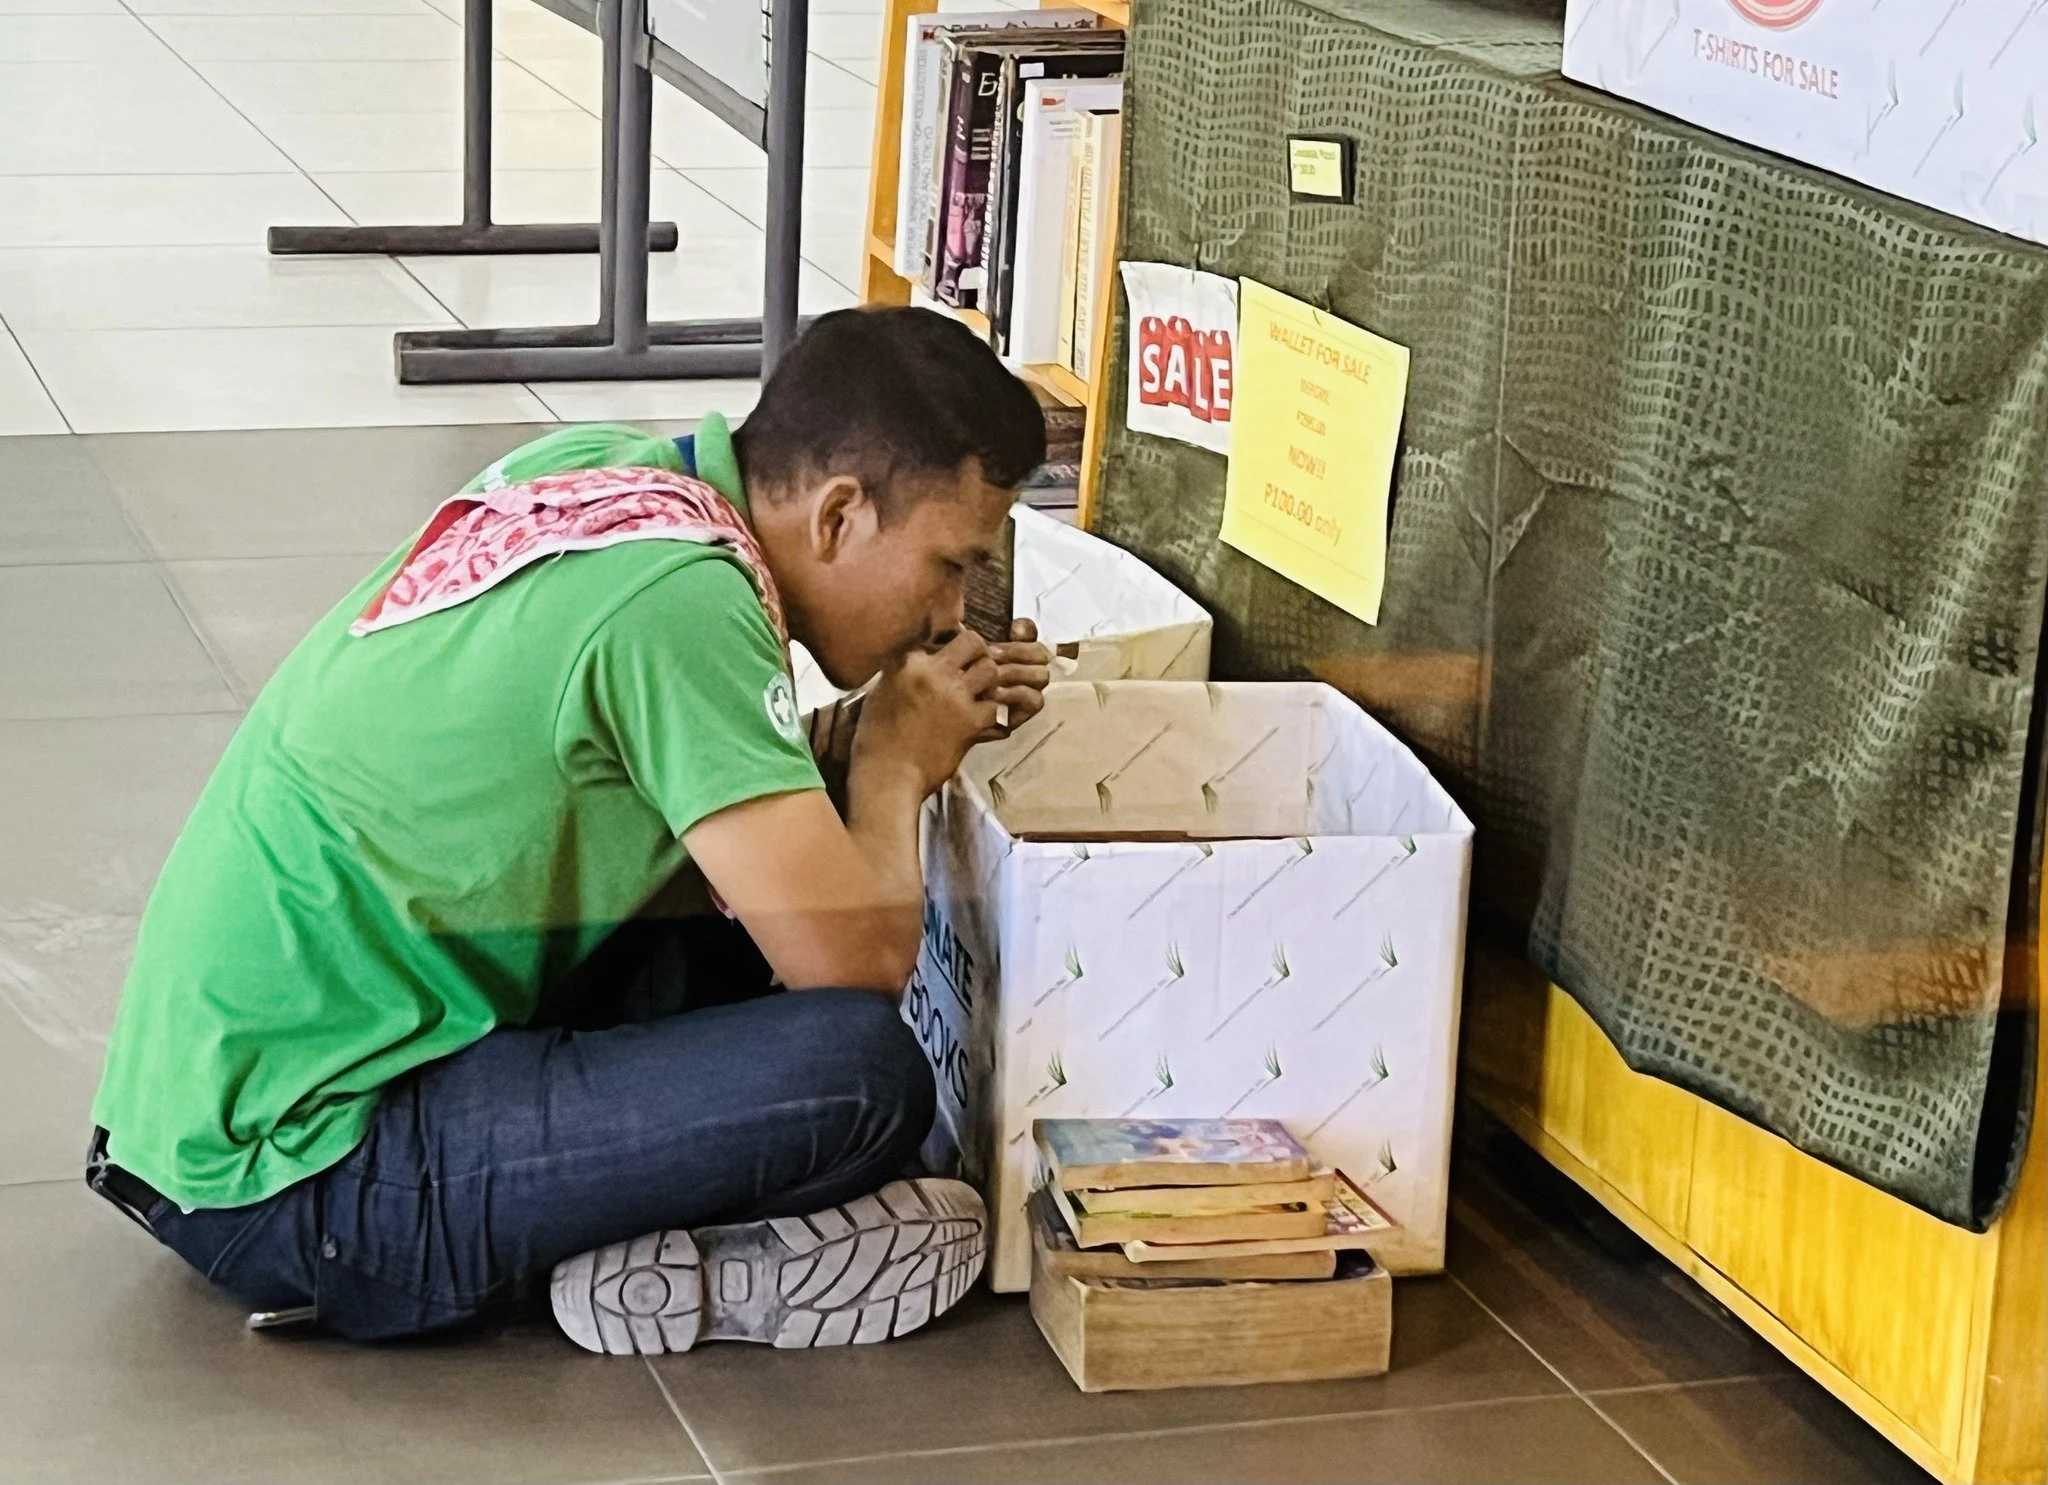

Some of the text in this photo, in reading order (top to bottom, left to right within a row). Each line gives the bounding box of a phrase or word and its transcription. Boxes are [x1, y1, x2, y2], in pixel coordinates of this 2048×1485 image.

[1693, 28, 1838, 100] T-SHIRTS FOR SALE
[1142, 343, 1231, 411] SALE
[1270, 322, 1372, 385] WALLET FOR SALE
[924, 888, 974, 1009] NATE
[909, 964, 969, 1110] BOOKS
